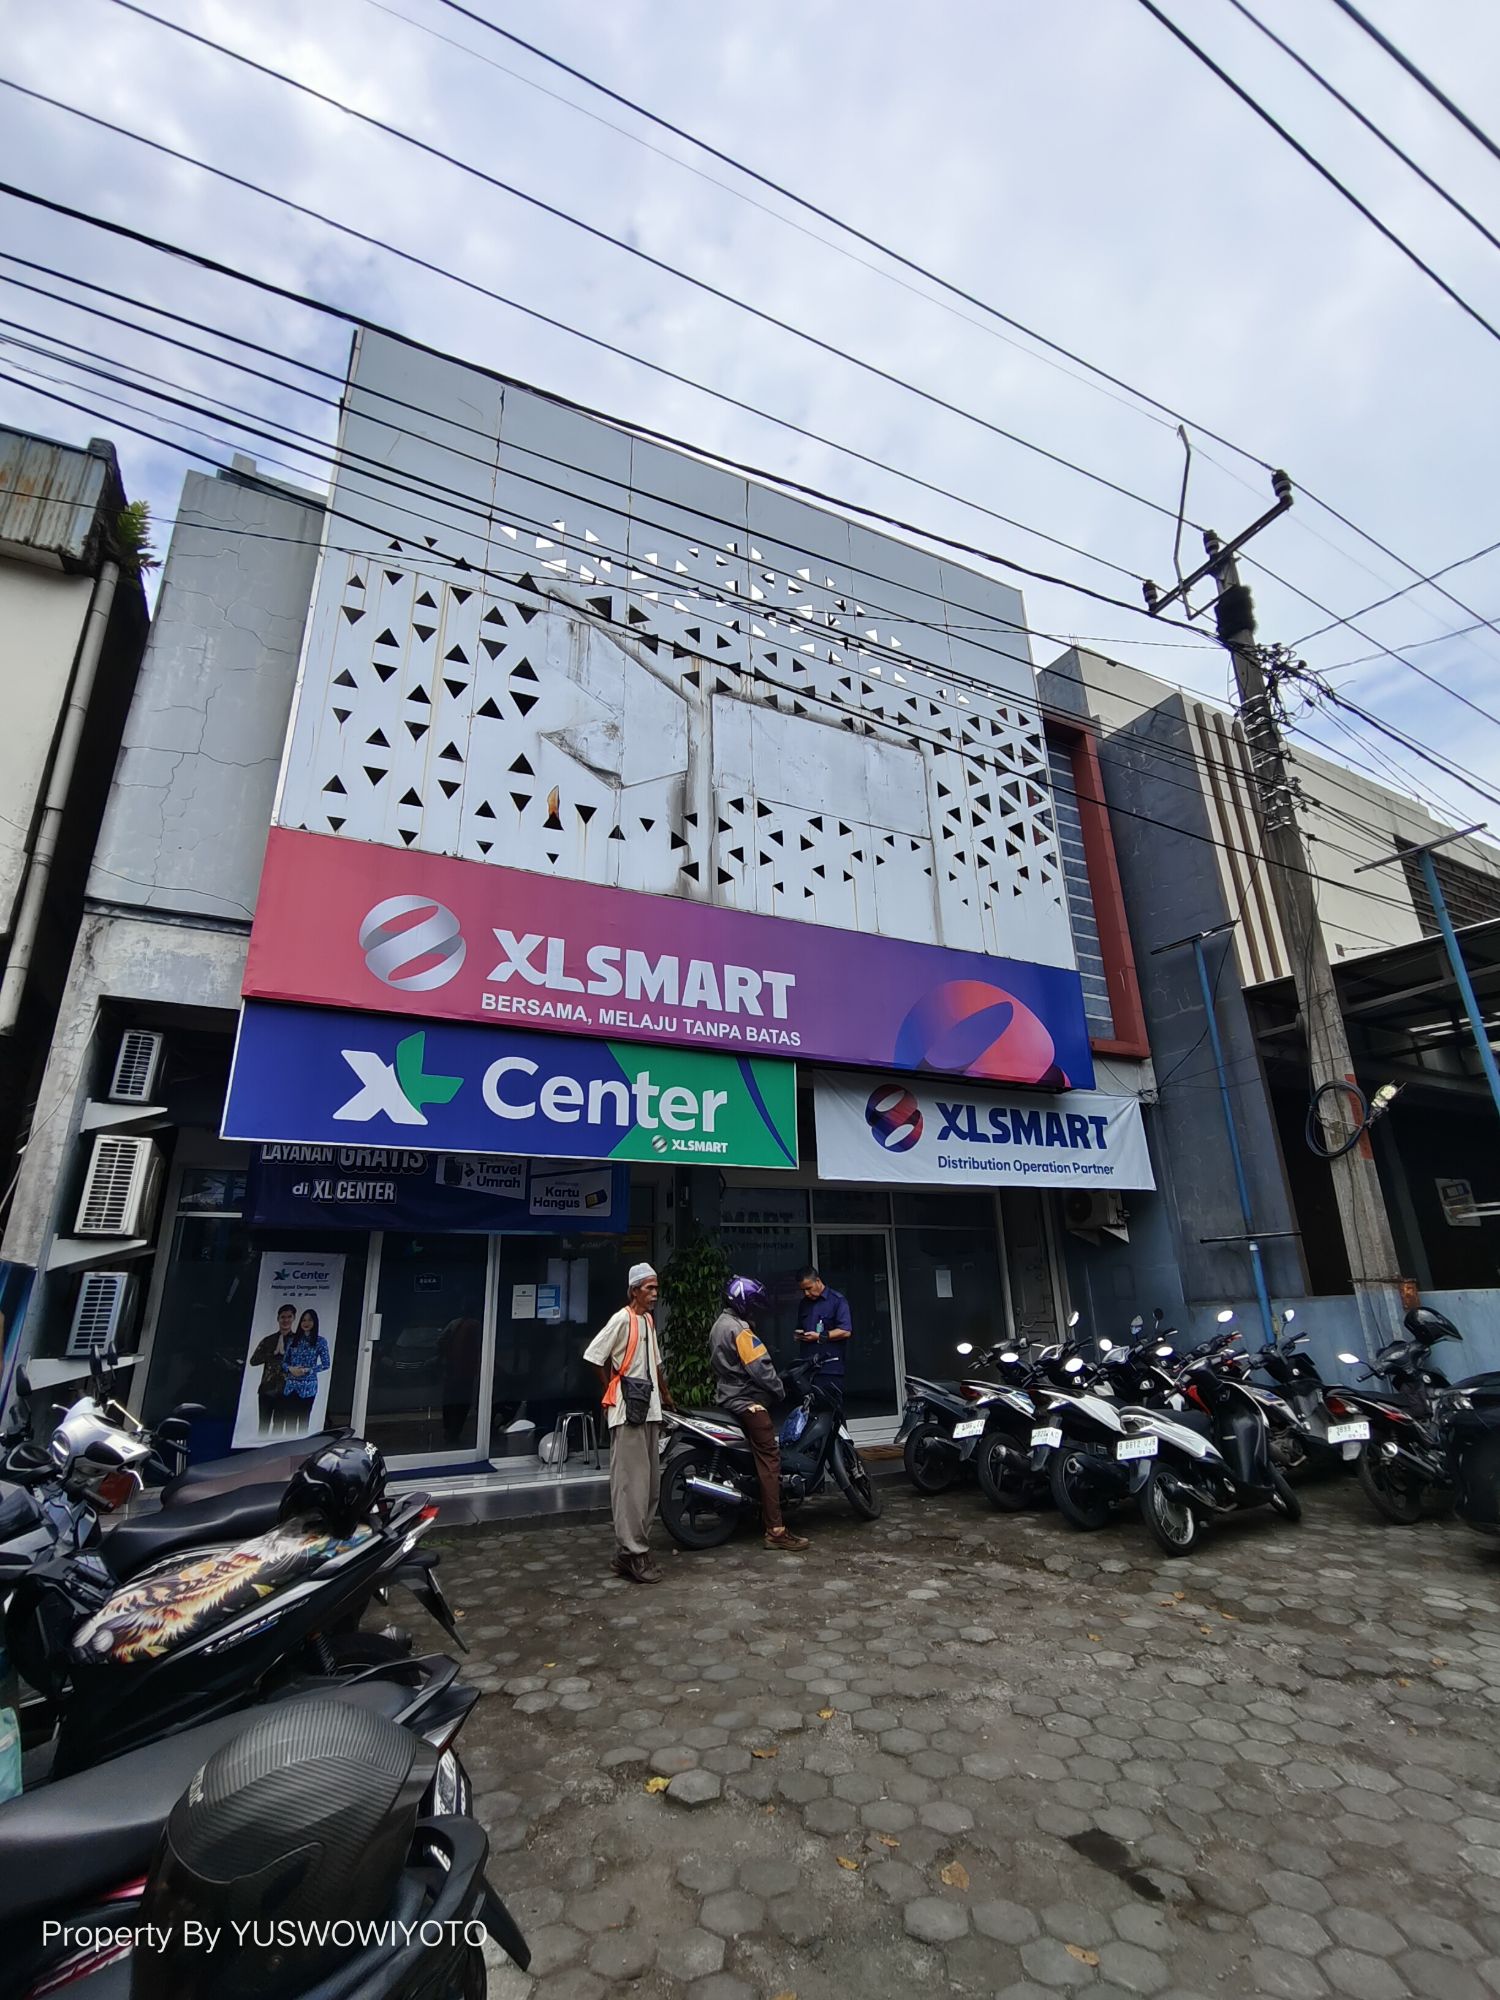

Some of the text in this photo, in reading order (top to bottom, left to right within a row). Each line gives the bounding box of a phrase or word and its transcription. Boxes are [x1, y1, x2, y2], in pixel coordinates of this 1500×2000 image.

[486, 927, 796, 1020] XLSMART
[482, 993, 802, 1047] BERSAMA, MELAJU TANPA BATAS
[482, 1056, 729, 1133] Center
[937, 1102, 1109, 1150] XLSMART
[672, 1138, 729, 1153] XLSMART
[261, 1144, 424, 1169] LAYANAN GRATIS
[938, 1155, 1115, 1176] Distribution Operation Partner
[478, 1161, 522, 1176] Travel
[292, 1180, 395, 1201] di XL CENTER
[476, 1175, 521, 1188] Umrah
[546, 1186, 580, 1198] Kartu
[533, 1196, 580, 1210] Hangus
[292, 1269, 330, 1280] Center
